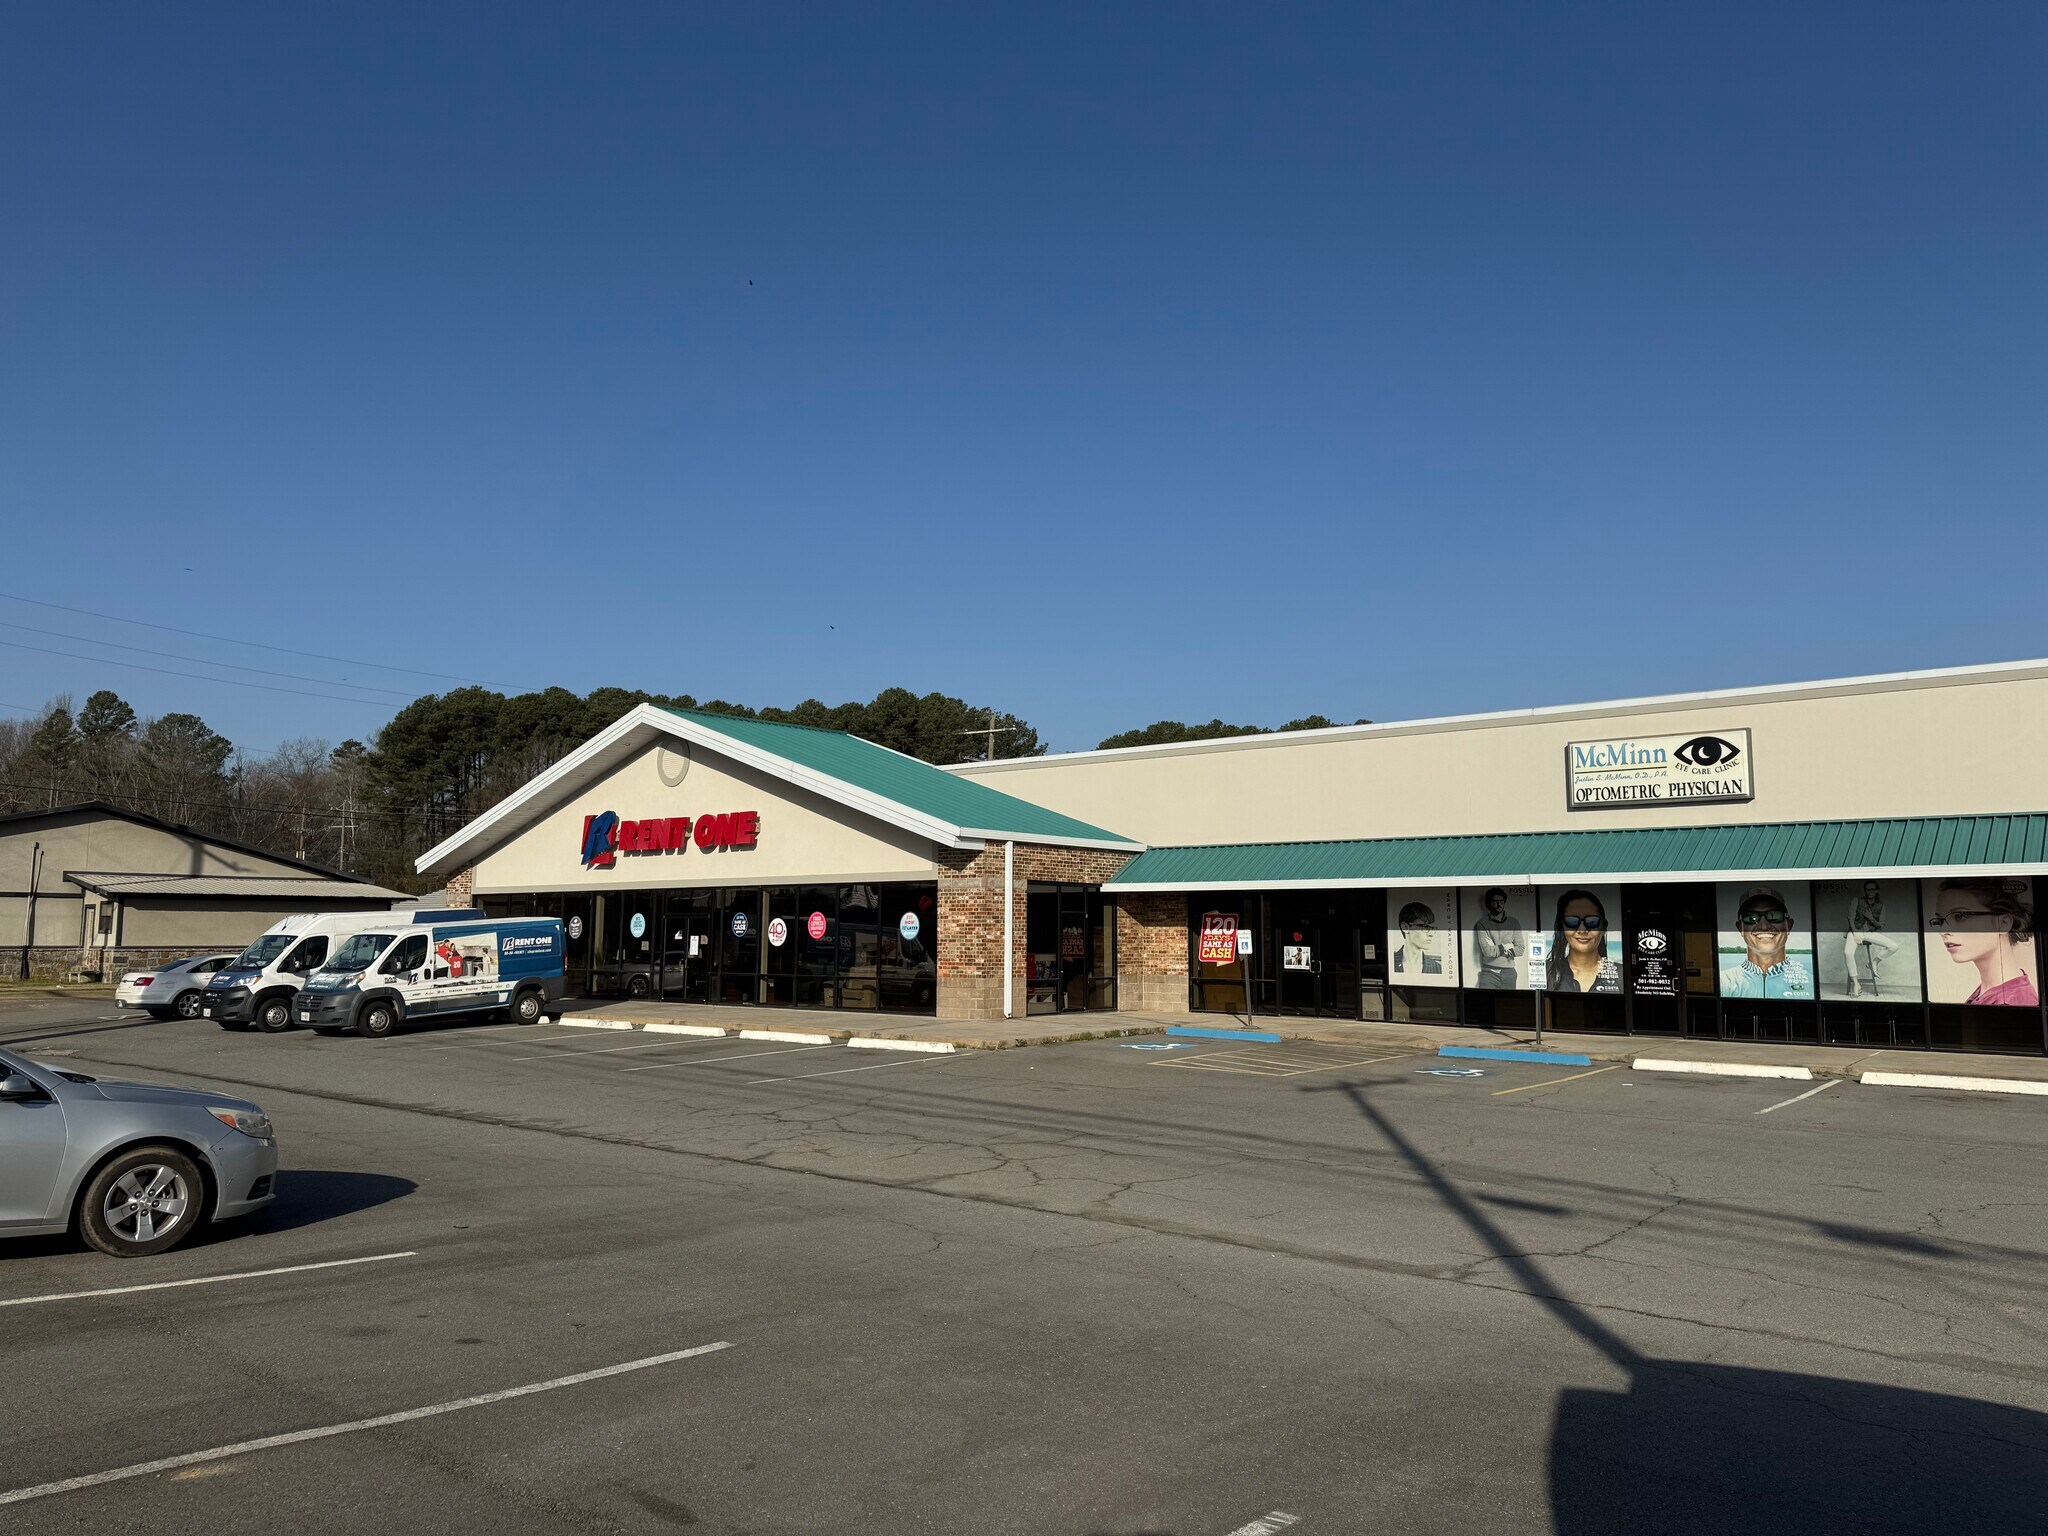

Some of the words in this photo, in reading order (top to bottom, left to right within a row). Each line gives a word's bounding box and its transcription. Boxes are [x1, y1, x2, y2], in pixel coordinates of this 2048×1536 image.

[1575, 743, 1667, 769] McMinn
[1675, 763, 1688, 773] EYE
[1692, 767, 1711, 775] CARE
[1715, 759, 1740, 773] CLINIC
[1576, 784, 1661, 802] OPTOMETRIC
[1669, 779, 1743, 797] PHYSICIAN
[619, 817, 690, 850] RENT
[694, 811, 758, 848] ONE
[1204, 917, 1235, 935] 120
[1638, 929, 1667, 941] McMinn
[1202, 948, 1232, 958] CASH
